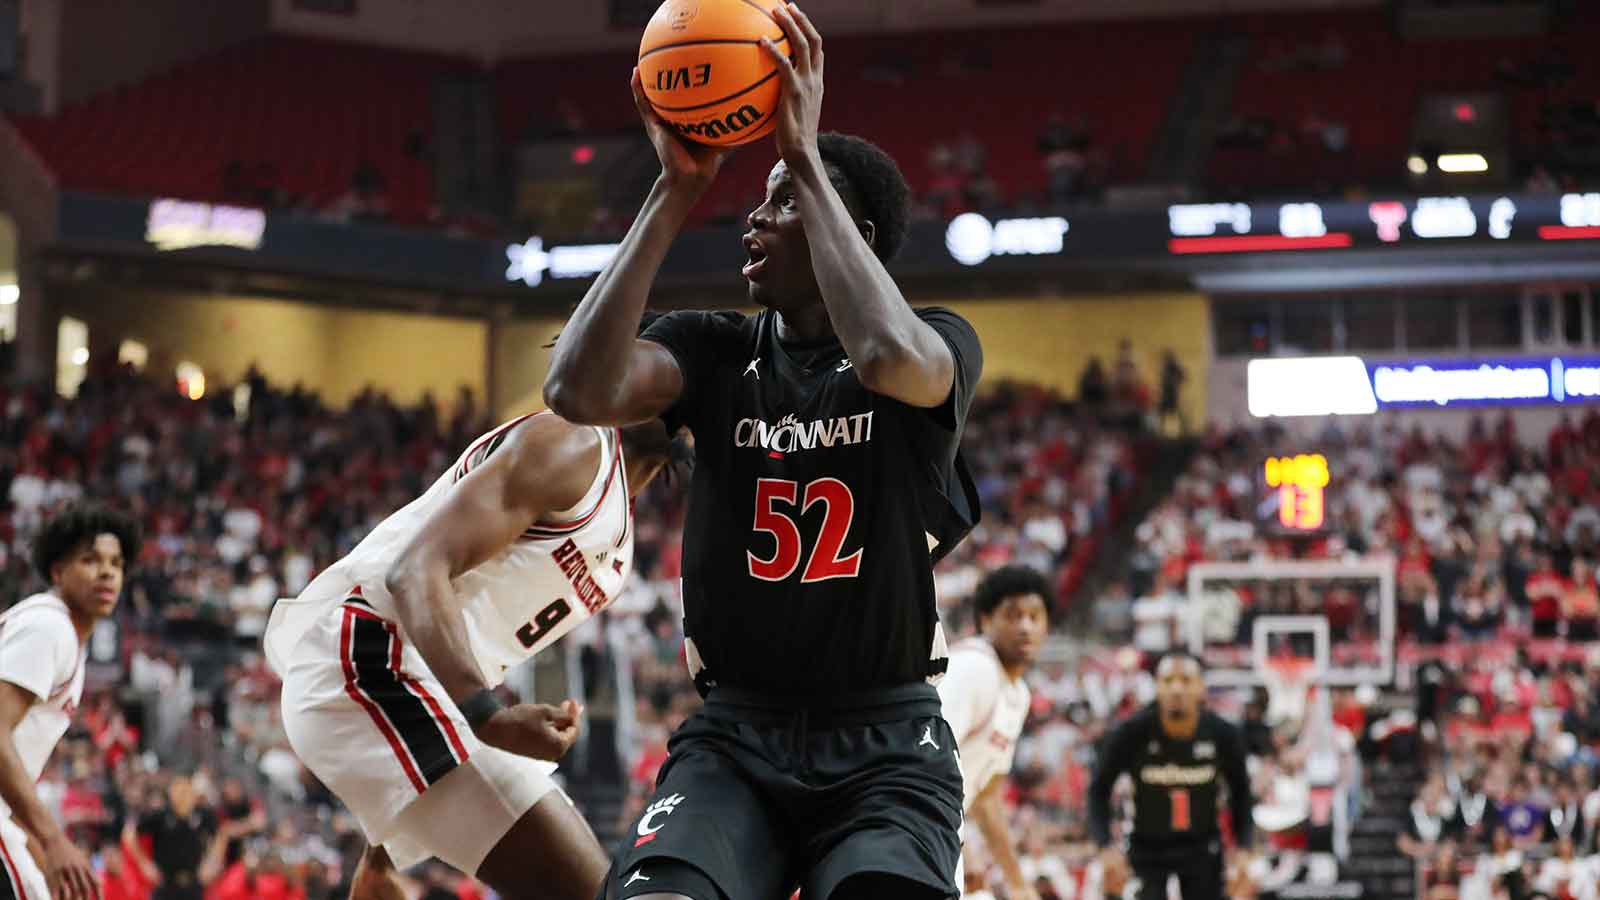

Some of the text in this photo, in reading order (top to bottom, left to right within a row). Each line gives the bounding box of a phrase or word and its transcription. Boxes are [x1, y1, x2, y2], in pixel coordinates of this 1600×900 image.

[735, 410, 875, 454] CINCINNATI
[747, 477, 864, 583] 52
[515, 598, 572, 649] 9
[1171, 788, 1190, 831] 1
